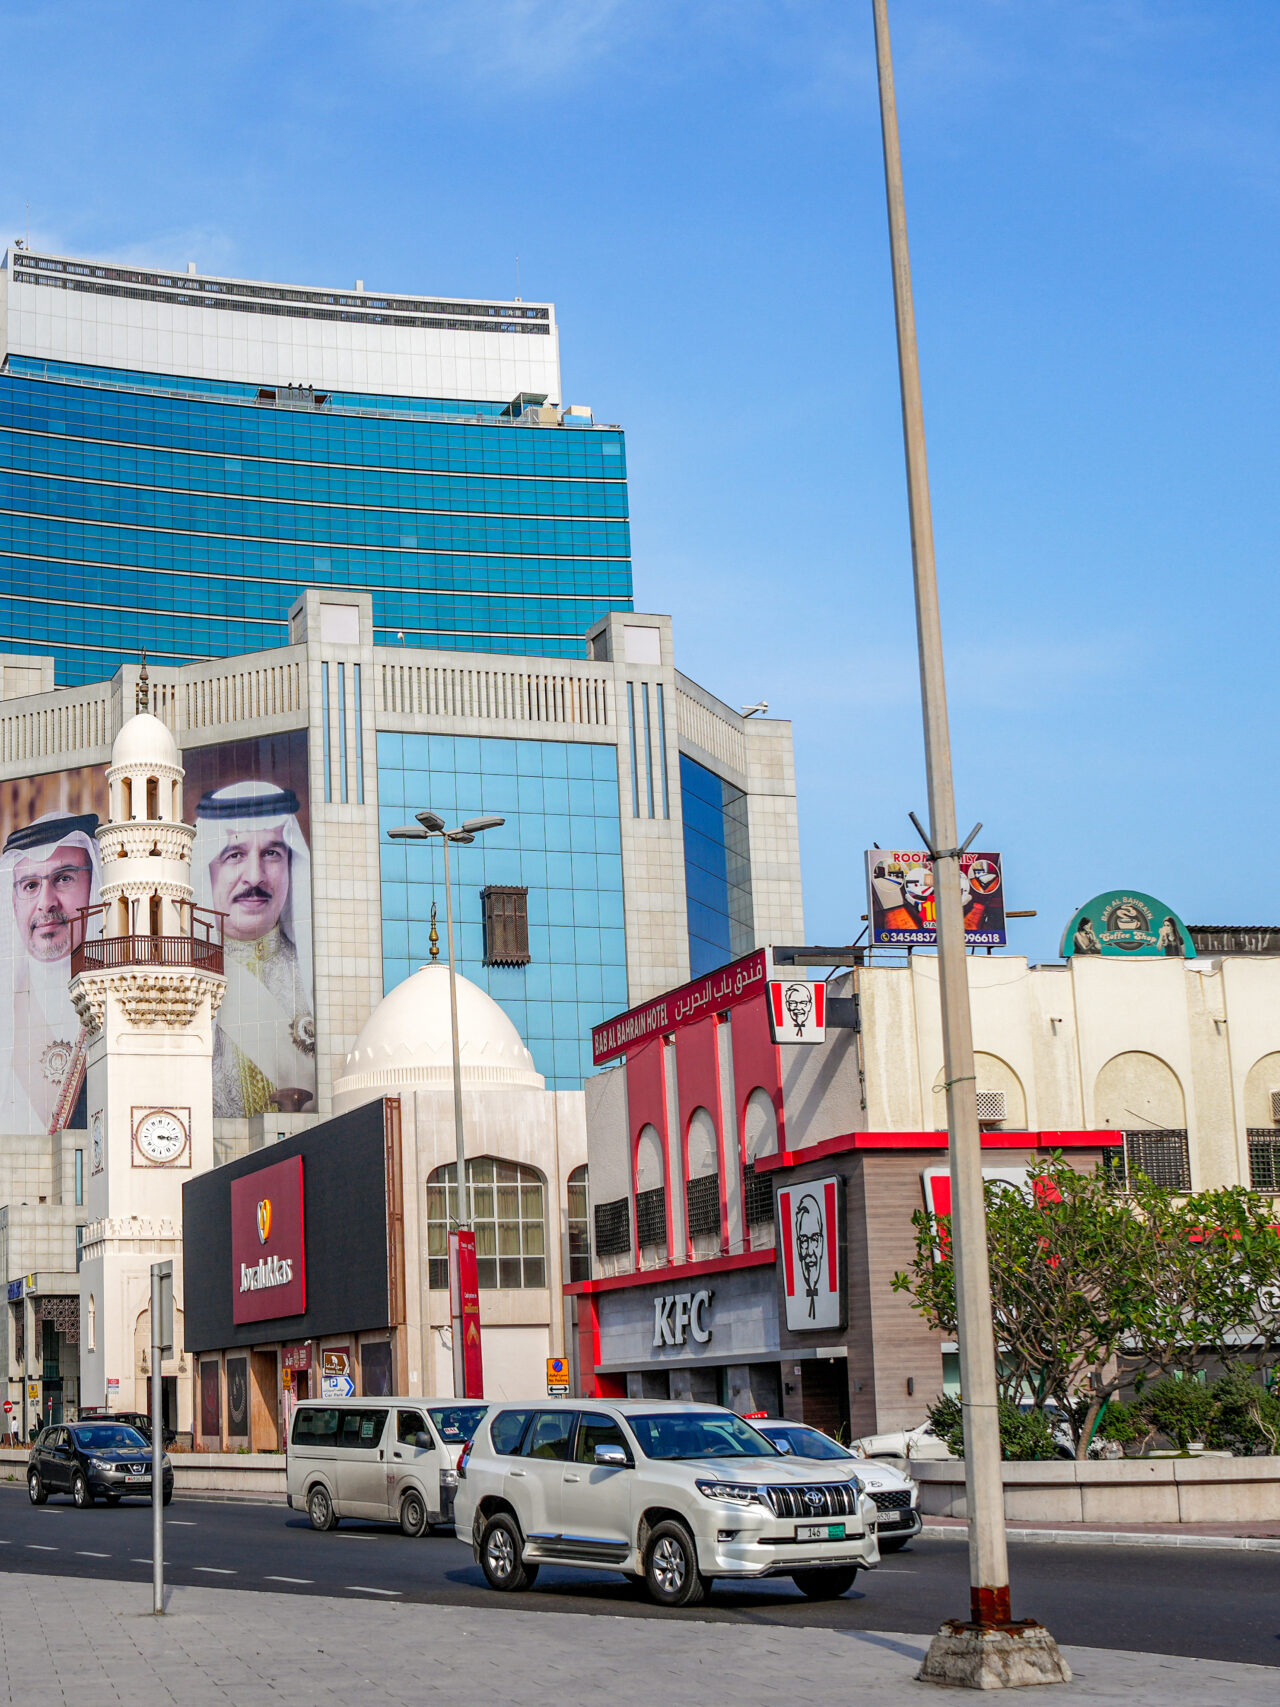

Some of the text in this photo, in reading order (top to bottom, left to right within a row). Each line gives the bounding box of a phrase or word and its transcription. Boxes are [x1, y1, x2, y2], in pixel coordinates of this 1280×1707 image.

[960, 853, 978, 865] ILY
[1101, 896, 1154, 922] BAB AL BAHRAIN
[923, 921, 936, 929] STA
[891, 933, 1000, 943] 3454837 096618
[1100, 931, 1157, 943] Coffee Shop
[674, 959, 763, 1021] فندق باب البحرين
[594, 1002, 669, 1056] BAB AL BAHRAIN HOTEL
[653, 1289, 711, 1346] KFC
